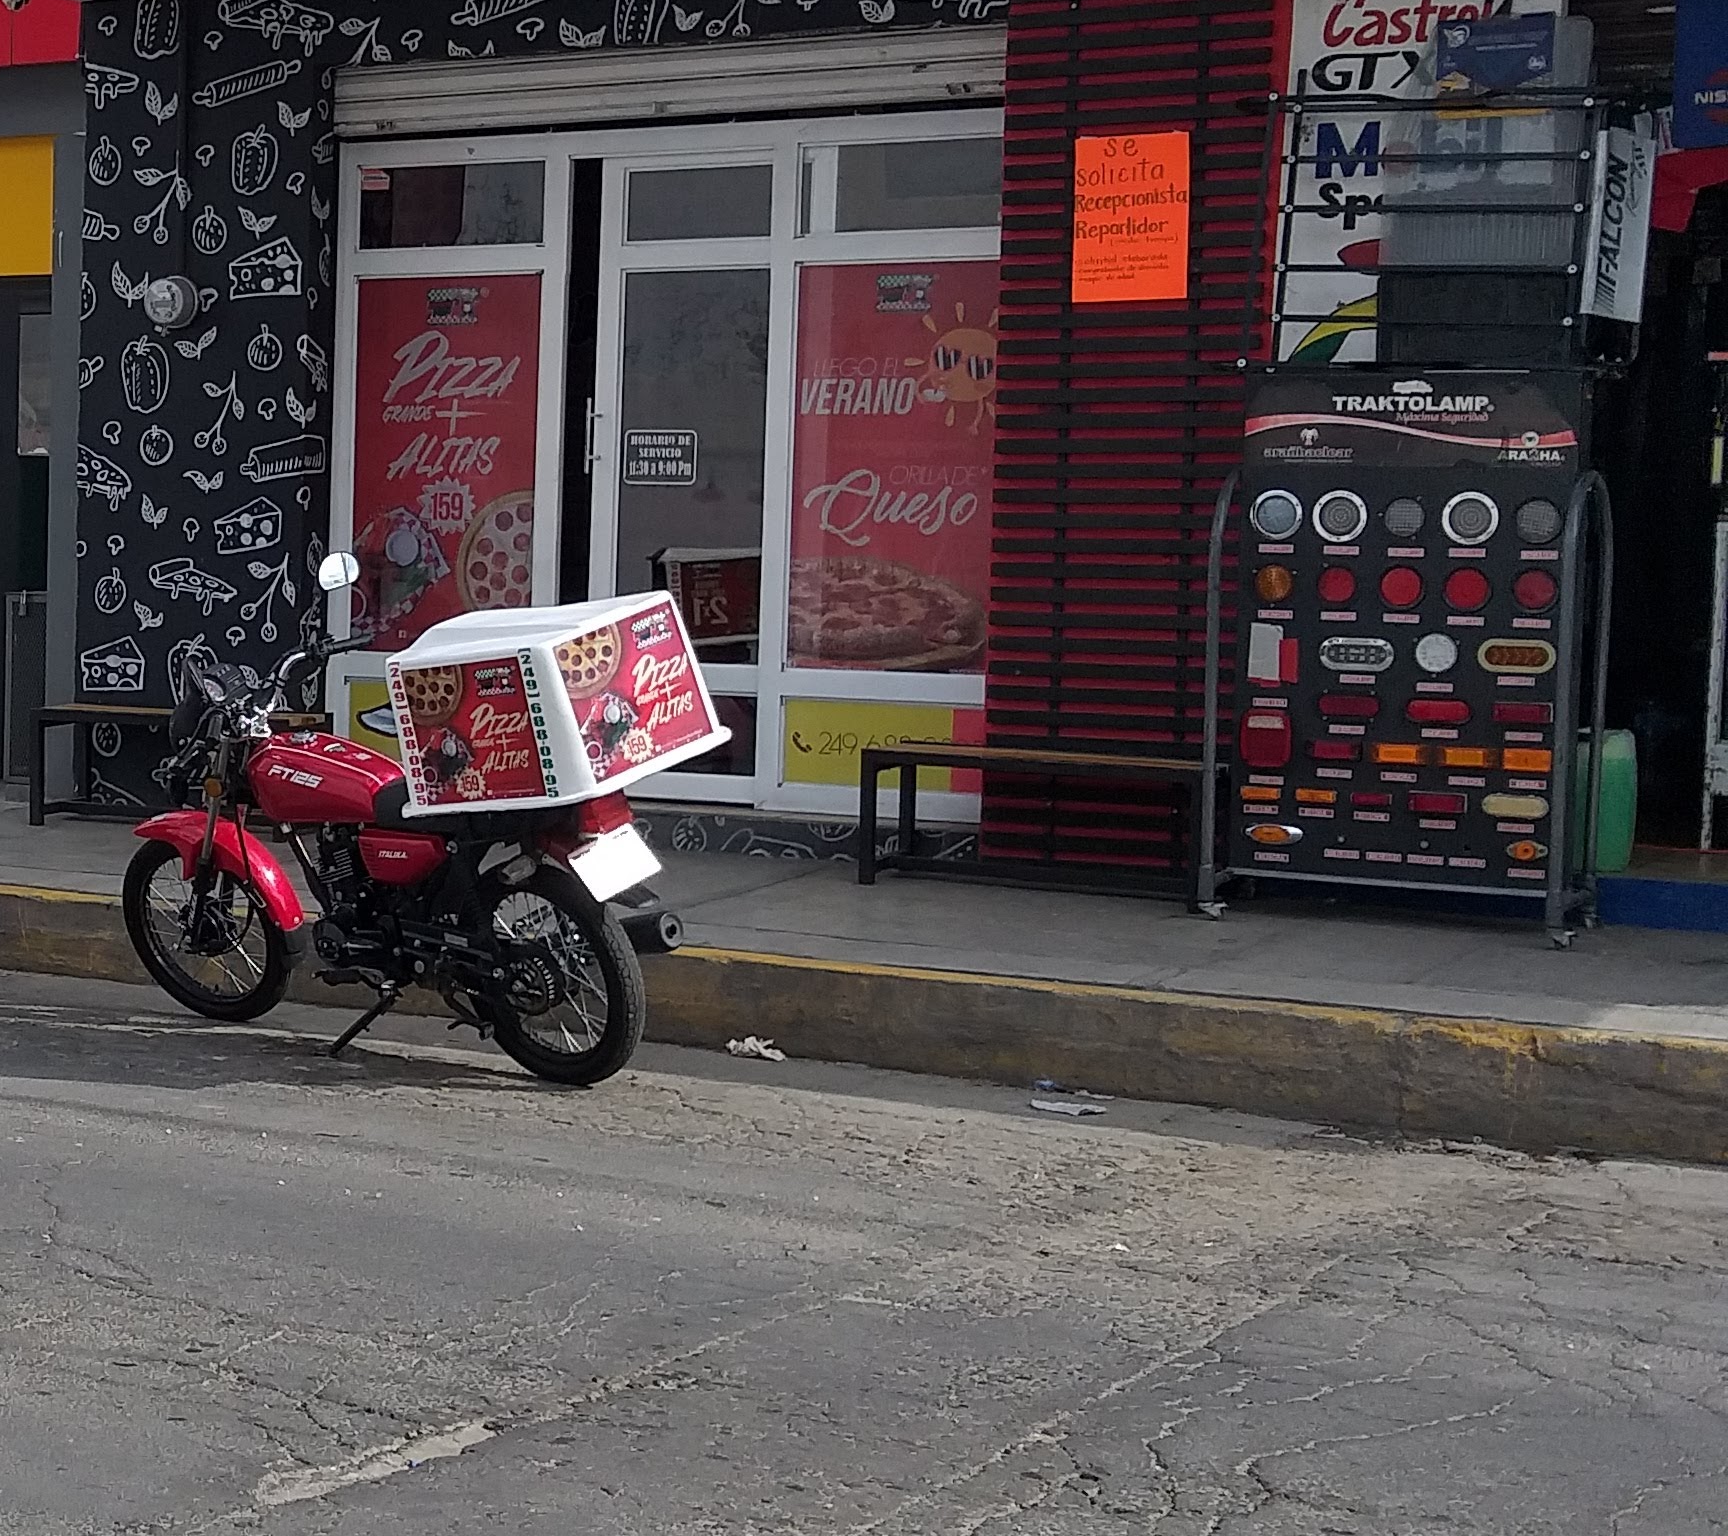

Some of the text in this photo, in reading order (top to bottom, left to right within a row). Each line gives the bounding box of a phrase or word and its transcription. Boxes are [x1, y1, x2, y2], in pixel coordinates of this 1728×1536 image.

[1694, 89, 1728, 105] NIS
[1074, 182, 1188, 215] Recepcionista
[1075, 216, 1169, 244] Repartidor
[1597, 151, 1629, 286] FALCON
[382, 329, 521, 404] PIZZA
[800, 377, 918, 415] VERANO
[1332, 394, 1490, 412] TRAKTOLAMP
[630, 434, 691, 446] HORARIO DE
[638, 447, 682, 458] SERVICIO
[386, 431, 501, 481] ALITAS
[629, 460, 649, 476] 11:30
[657, 460, 677, 476] 9:00
[430, 491, 464, 521] 159
[803, 468, 978, 547] Queso
[632, 651, 689, 698] PIZZA
[469, 702, 530, 740] PIZZA
[646, 690, 694, 732] ALITAS
[627, 735, 648, 757] 159
[818, 731, 858, 756] 249
[480, 748, 530, 775] ALITAS
[267, 763, 325, 789] FT125
[461, 775, 480, 792] 159
